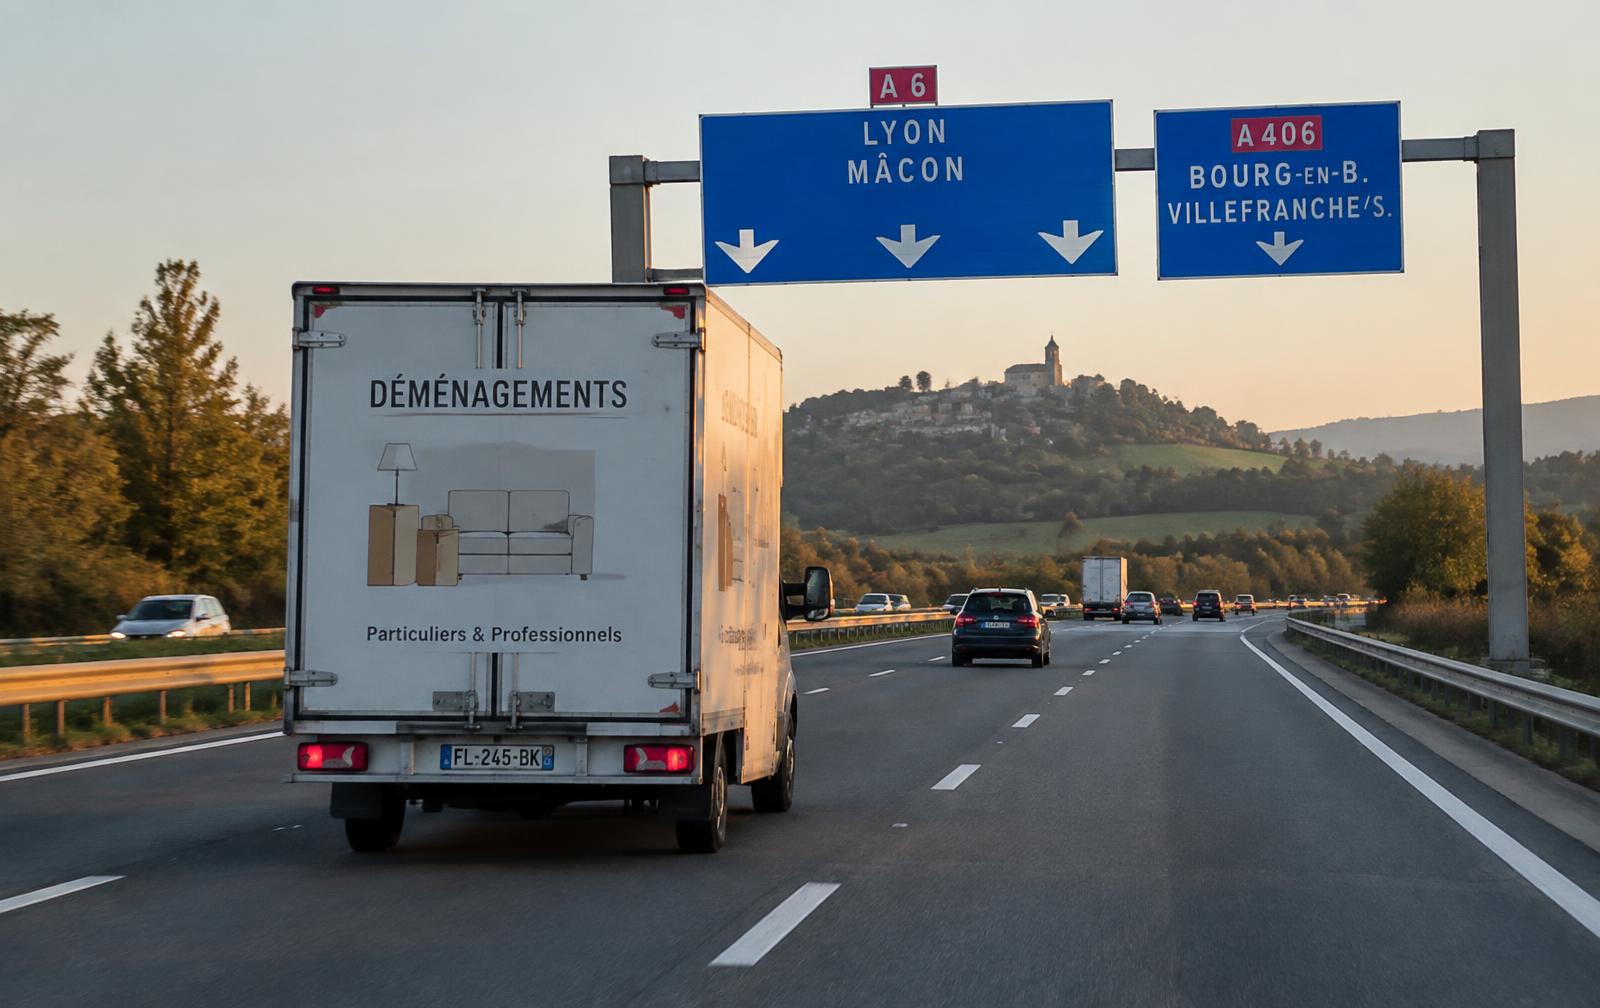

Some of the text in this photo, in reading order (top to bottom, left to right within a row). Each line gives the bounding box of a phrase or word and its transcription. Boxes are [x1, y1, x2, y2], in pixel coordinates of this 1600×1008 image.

[880, 72, 926, 99] A 6
[864, 118, 945, 146] LYON
[848, 152, 963, 185] MÂCON
[1190, 160, 1368, 189] BOURG-EN-B.
[1168, 195, 1392, 224] VILLEFRANCHE/S.
[370, 373, 628, 409] DÉMÉNAGEMENTS
[366, 625, 622, 643] Particuliers & Professionnels
[453, 748, 541, 766] FL-245-BK
